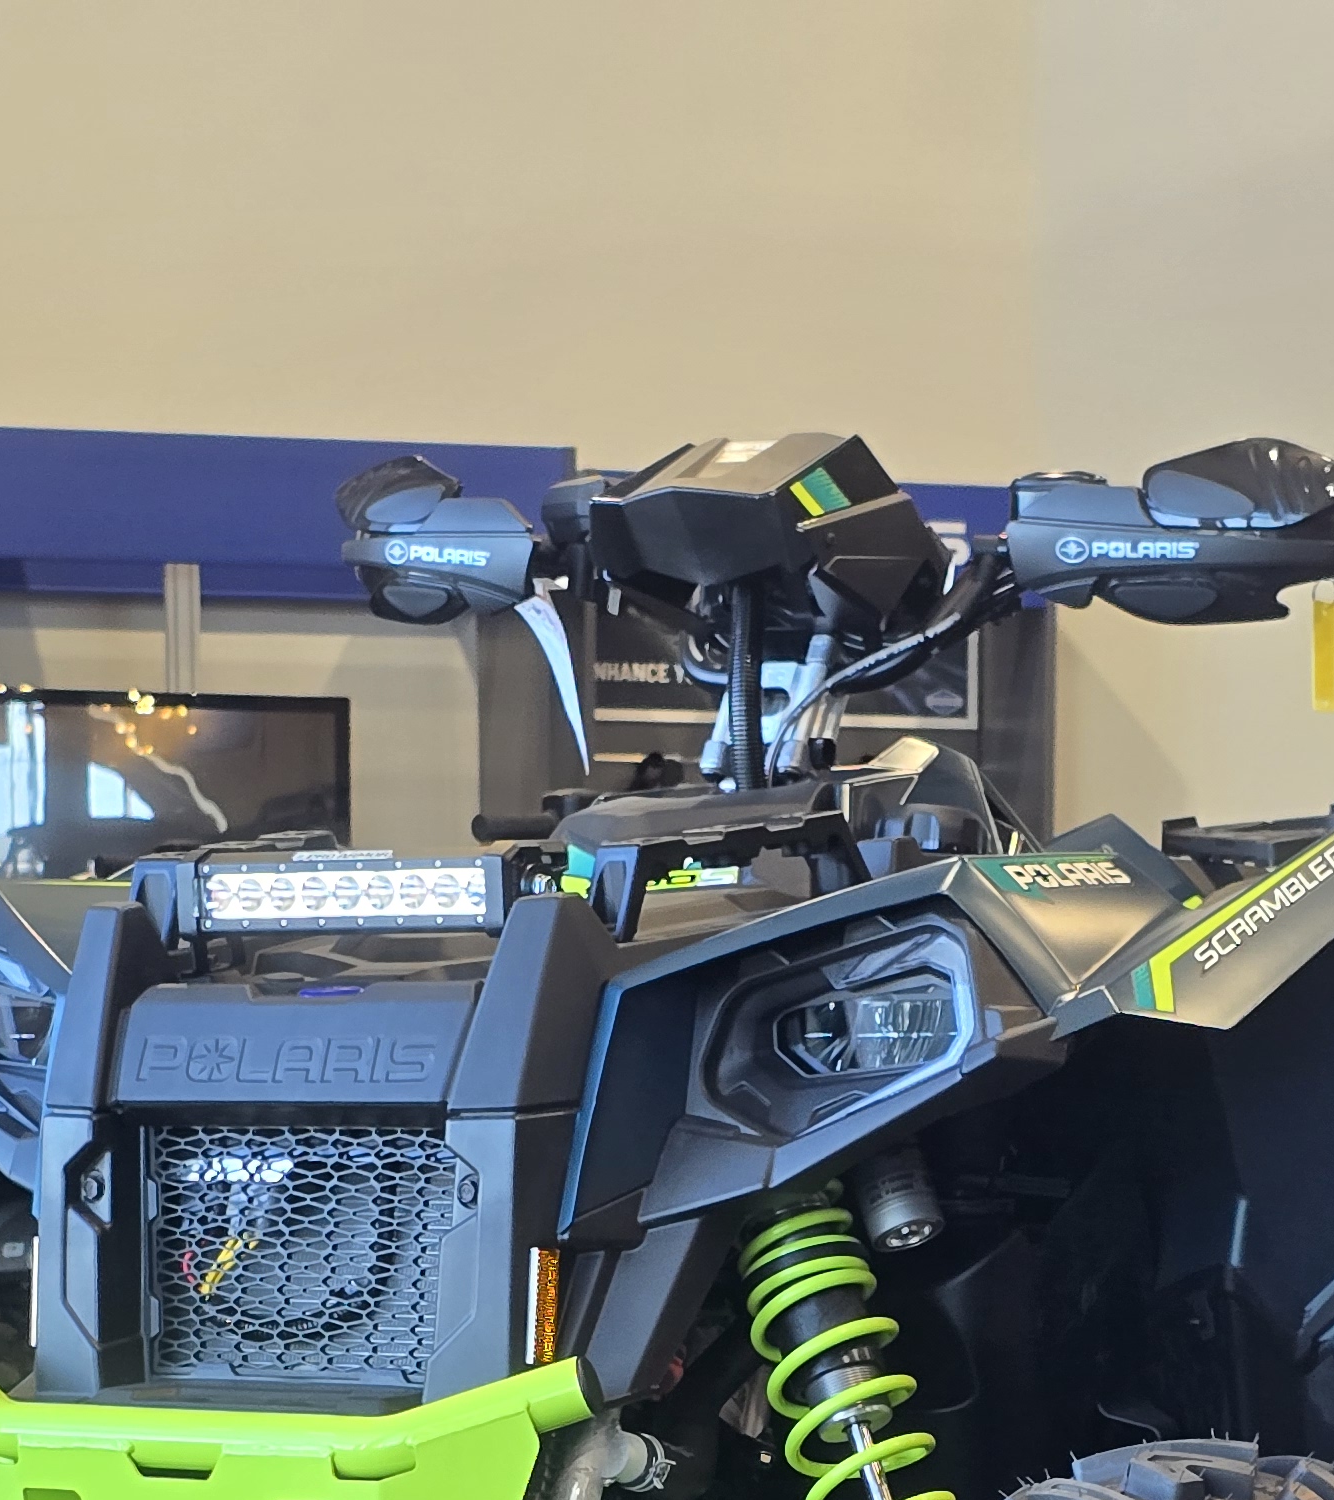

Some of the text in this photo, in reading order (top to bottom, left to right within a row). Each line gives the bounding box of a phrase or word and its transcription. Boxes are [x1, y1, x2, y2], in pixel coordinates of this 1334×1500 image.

[409, 545, 489, 566] POLARIS
[1092, 541, 1197, 559] POLARIS
[593, 662, 670, 683] NHANCE
[1002, 861, 1132, 891] POLARIS
[135, 1035, 436, 1084] POLARIS
